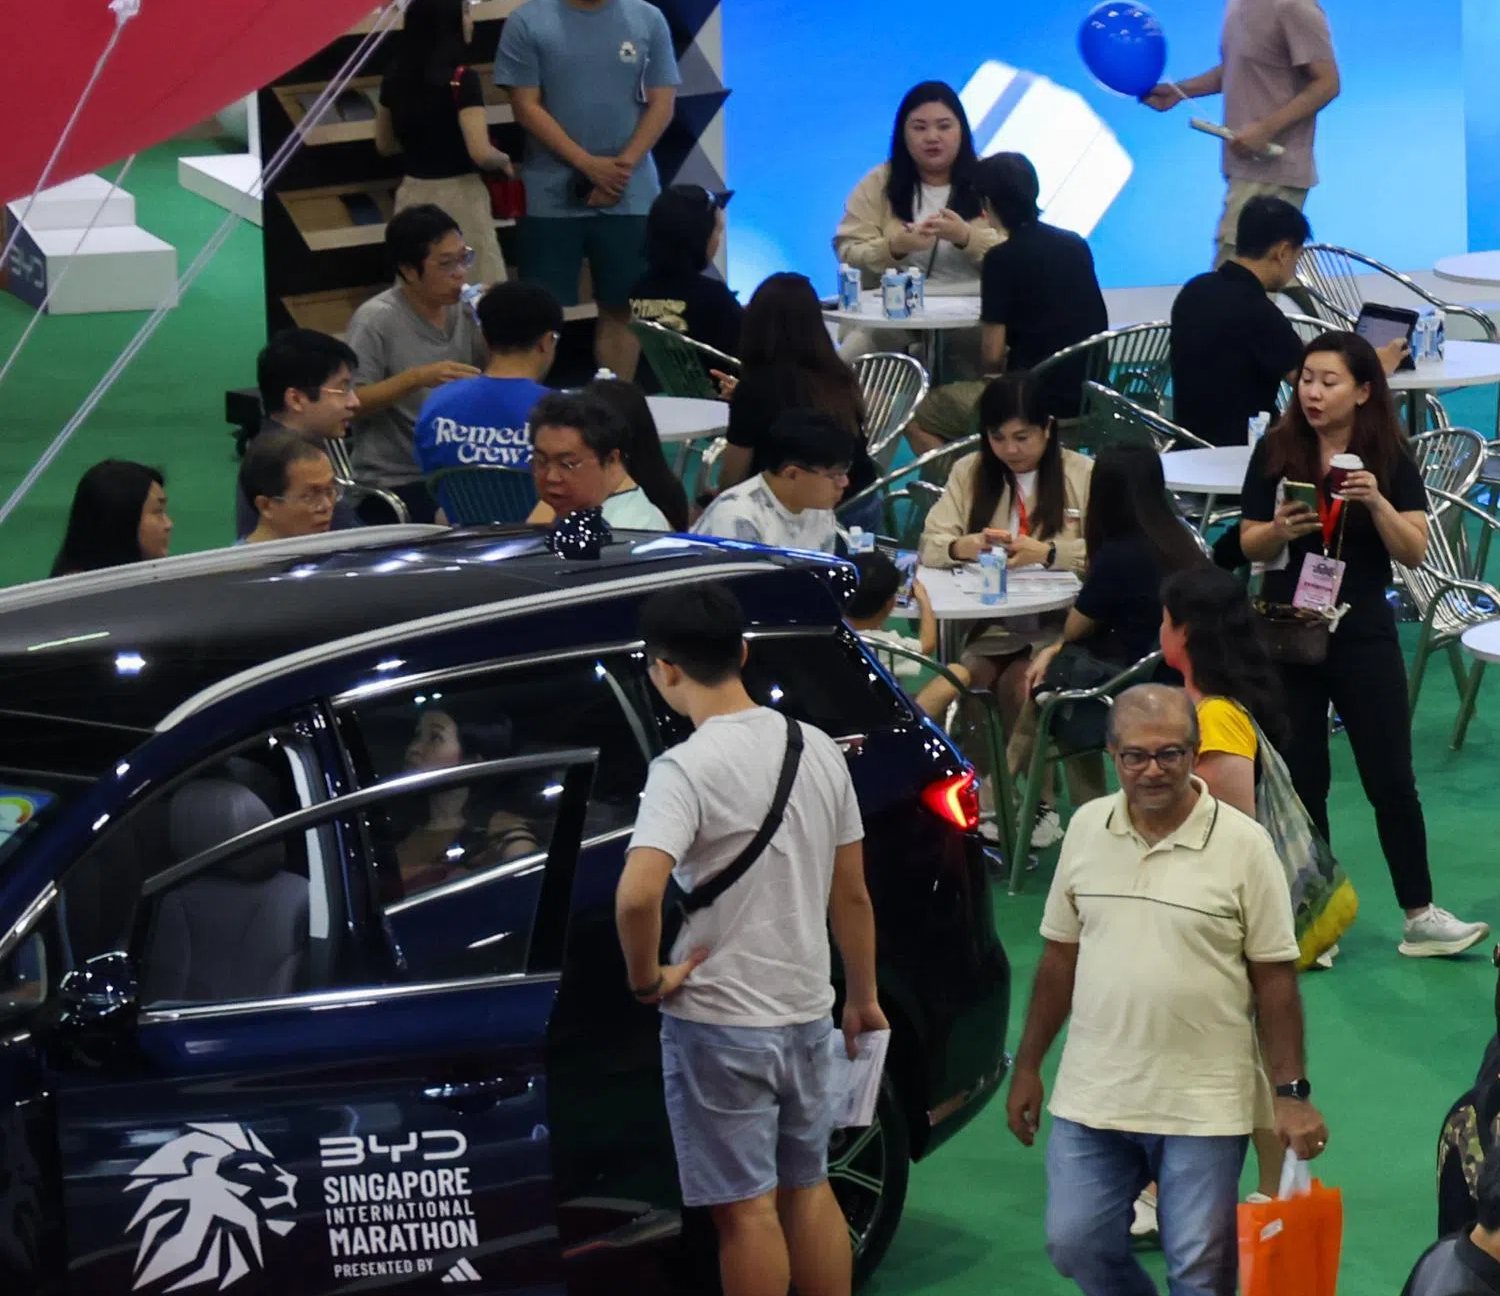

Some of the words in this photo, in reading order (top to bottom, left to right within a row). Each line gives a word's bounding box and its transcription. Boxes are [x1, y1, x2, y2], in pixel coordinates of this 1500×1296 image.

[434, 415, 531, 446] Remed
[457, 441, 522, 465] Crew
[319, 1129, 468, 1168] BYD
[323, 1167, 472, 1205] SINGAPORE
[325, 1200, 475, 1224] INTERNATIONAL
[328, 1222, 480, 1257] MARATHON
[333, 1259, 413, 1278] PRESENTED
[416, 1257, 434, 1273] BY
